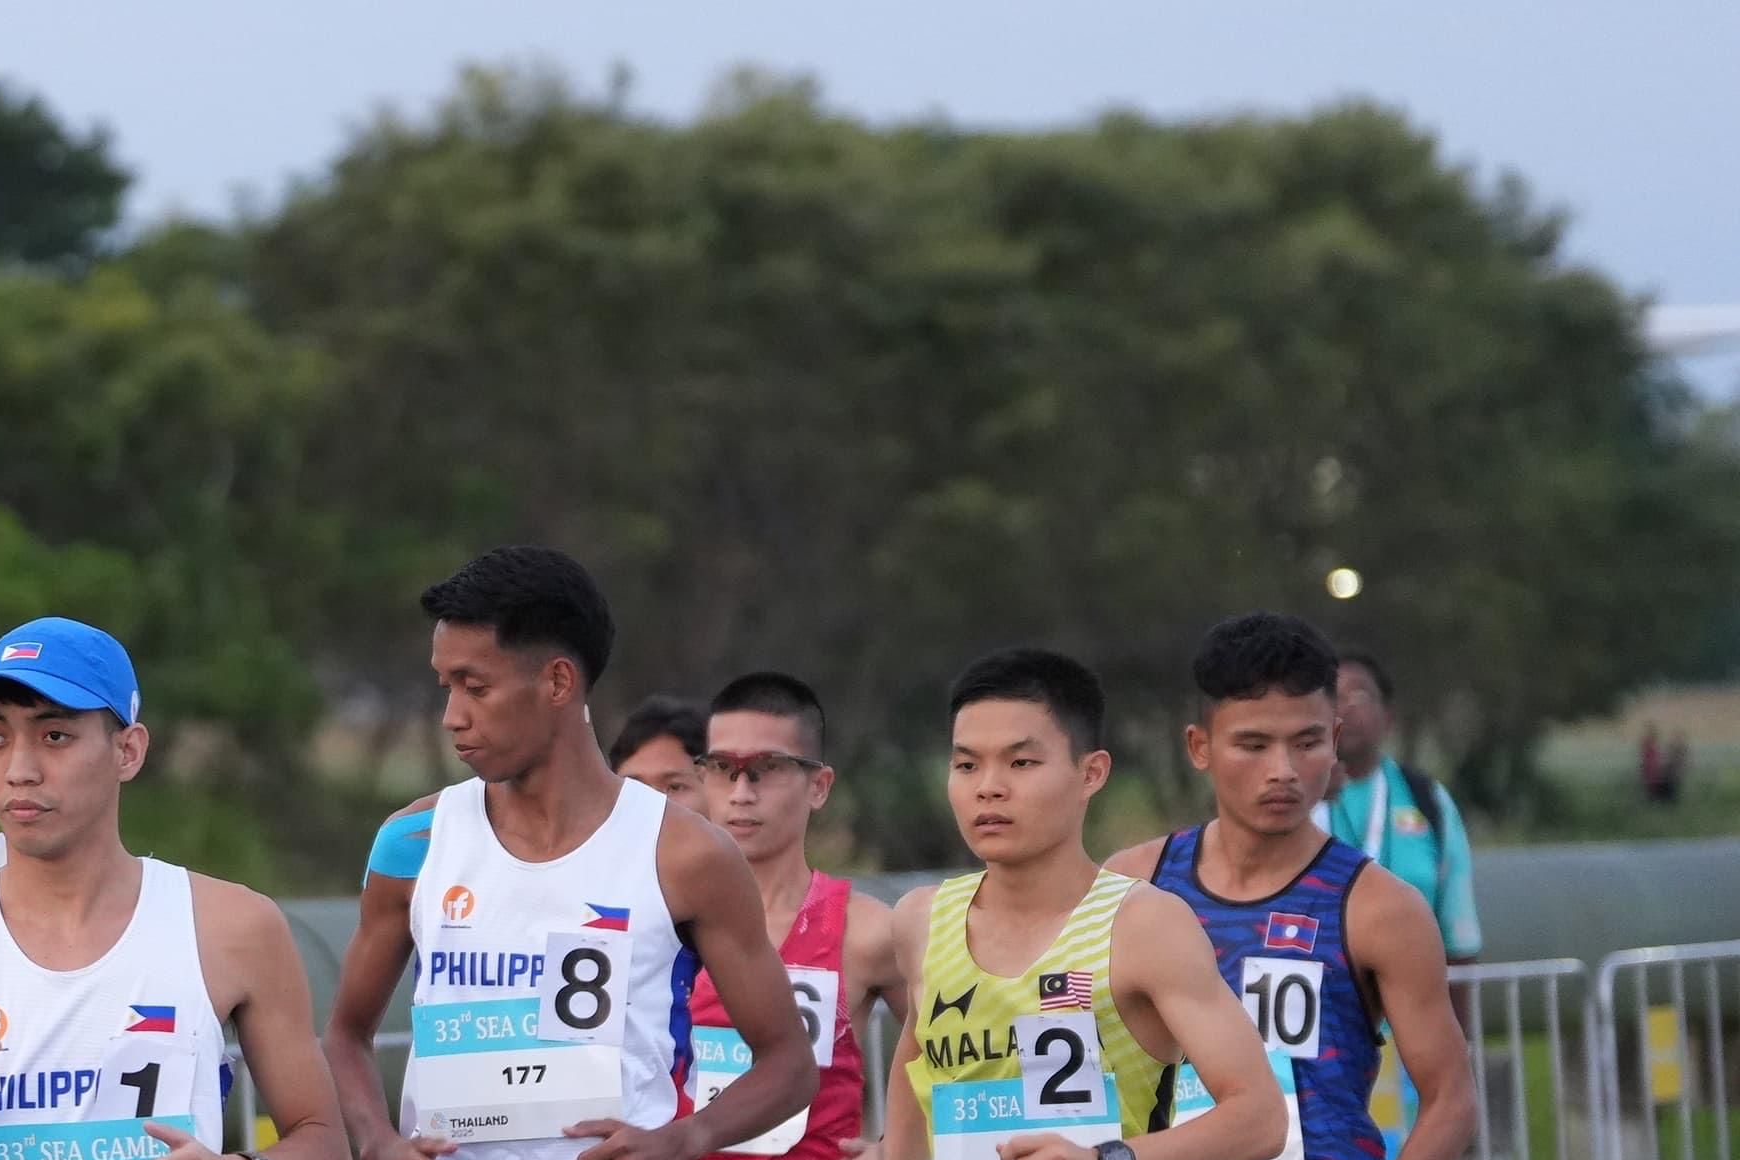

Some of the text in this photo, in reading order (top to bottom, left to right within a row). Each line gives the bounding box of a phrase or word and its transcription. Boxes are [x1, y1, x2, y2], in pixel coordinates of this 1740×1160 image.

[554, 947, 612, 1030] 8
[1245, 972, 1317, 1046] 10
[434, 1011, 472, 1043] 33rd
[475, 1015, 516, 1040] SEA
[502, 1064, 547, 1085] 177
[1034, 1027, 1093, 1105] 2
[119, 1062, 161, 1119] 1
[989, 1095, 1023, 1119] SEA
[449, 1115, 509, 1129] THAILAND
